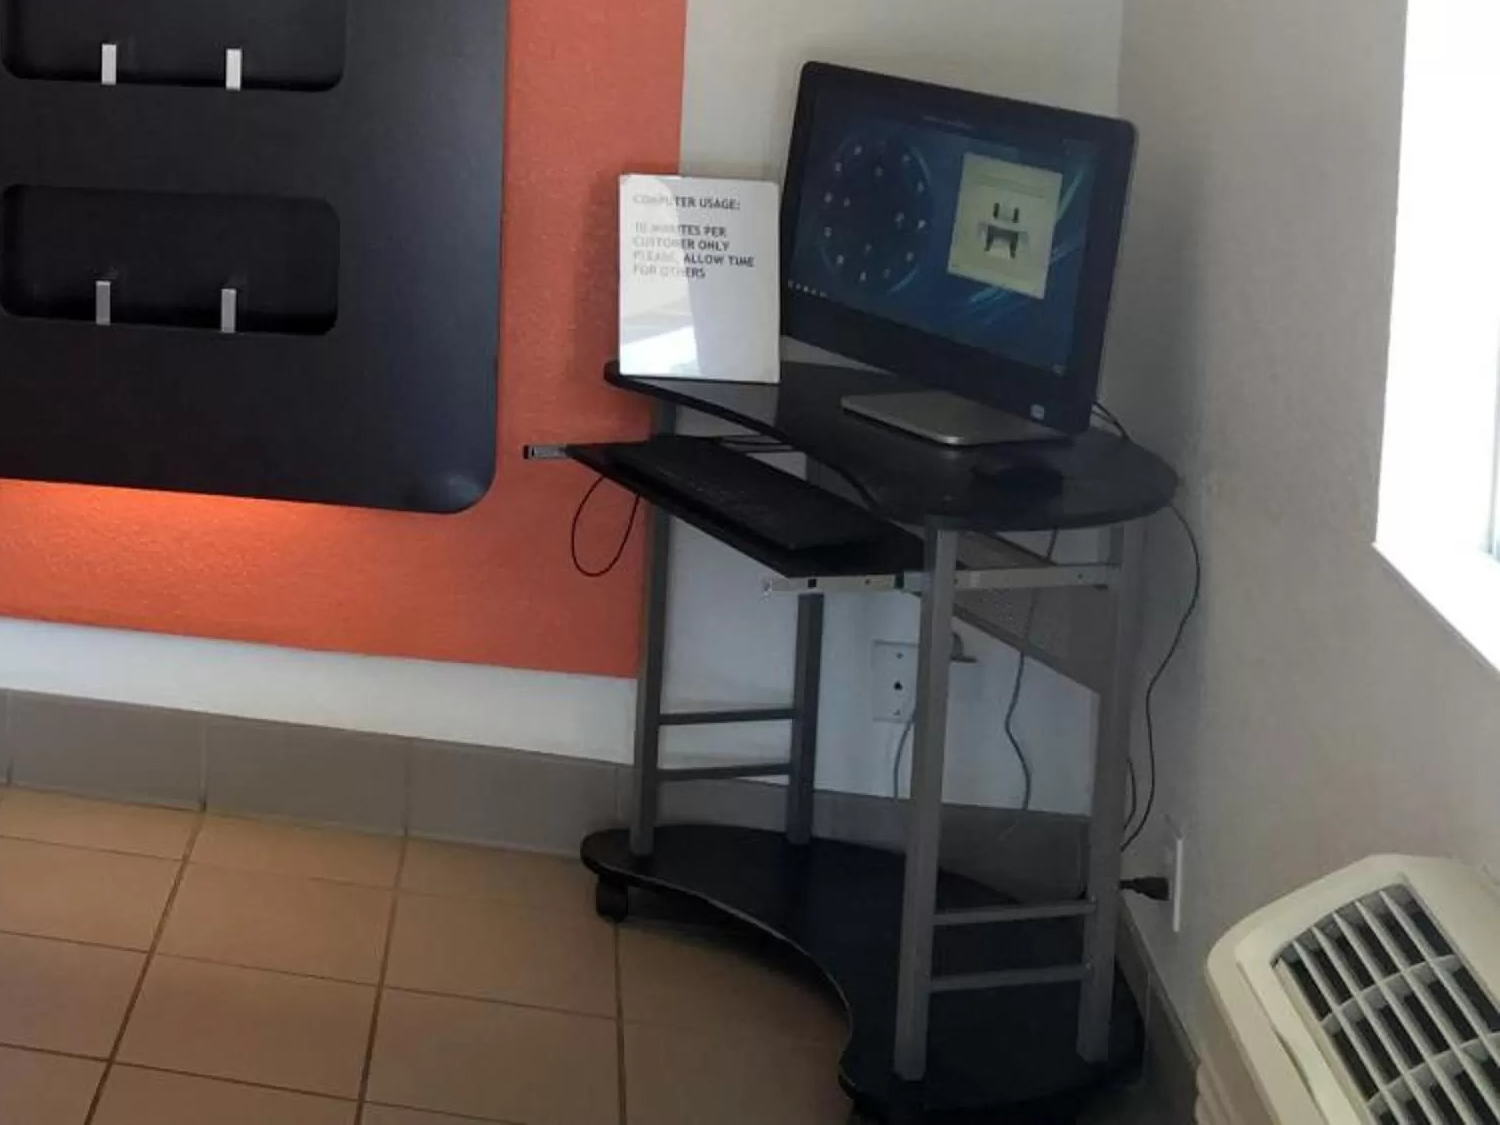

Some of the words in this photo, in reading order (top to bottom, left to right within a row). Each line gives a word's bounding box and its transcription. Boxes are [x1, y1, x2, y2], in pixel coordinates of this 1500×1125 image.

[699, 197, 741, 210] USAGE:
[703, 225, 727, 237] PER
[698, 239, 730, 252] ONLY
[683, 252, 725, 264] ALLOW
[728, 254, 756, 268] TIME
